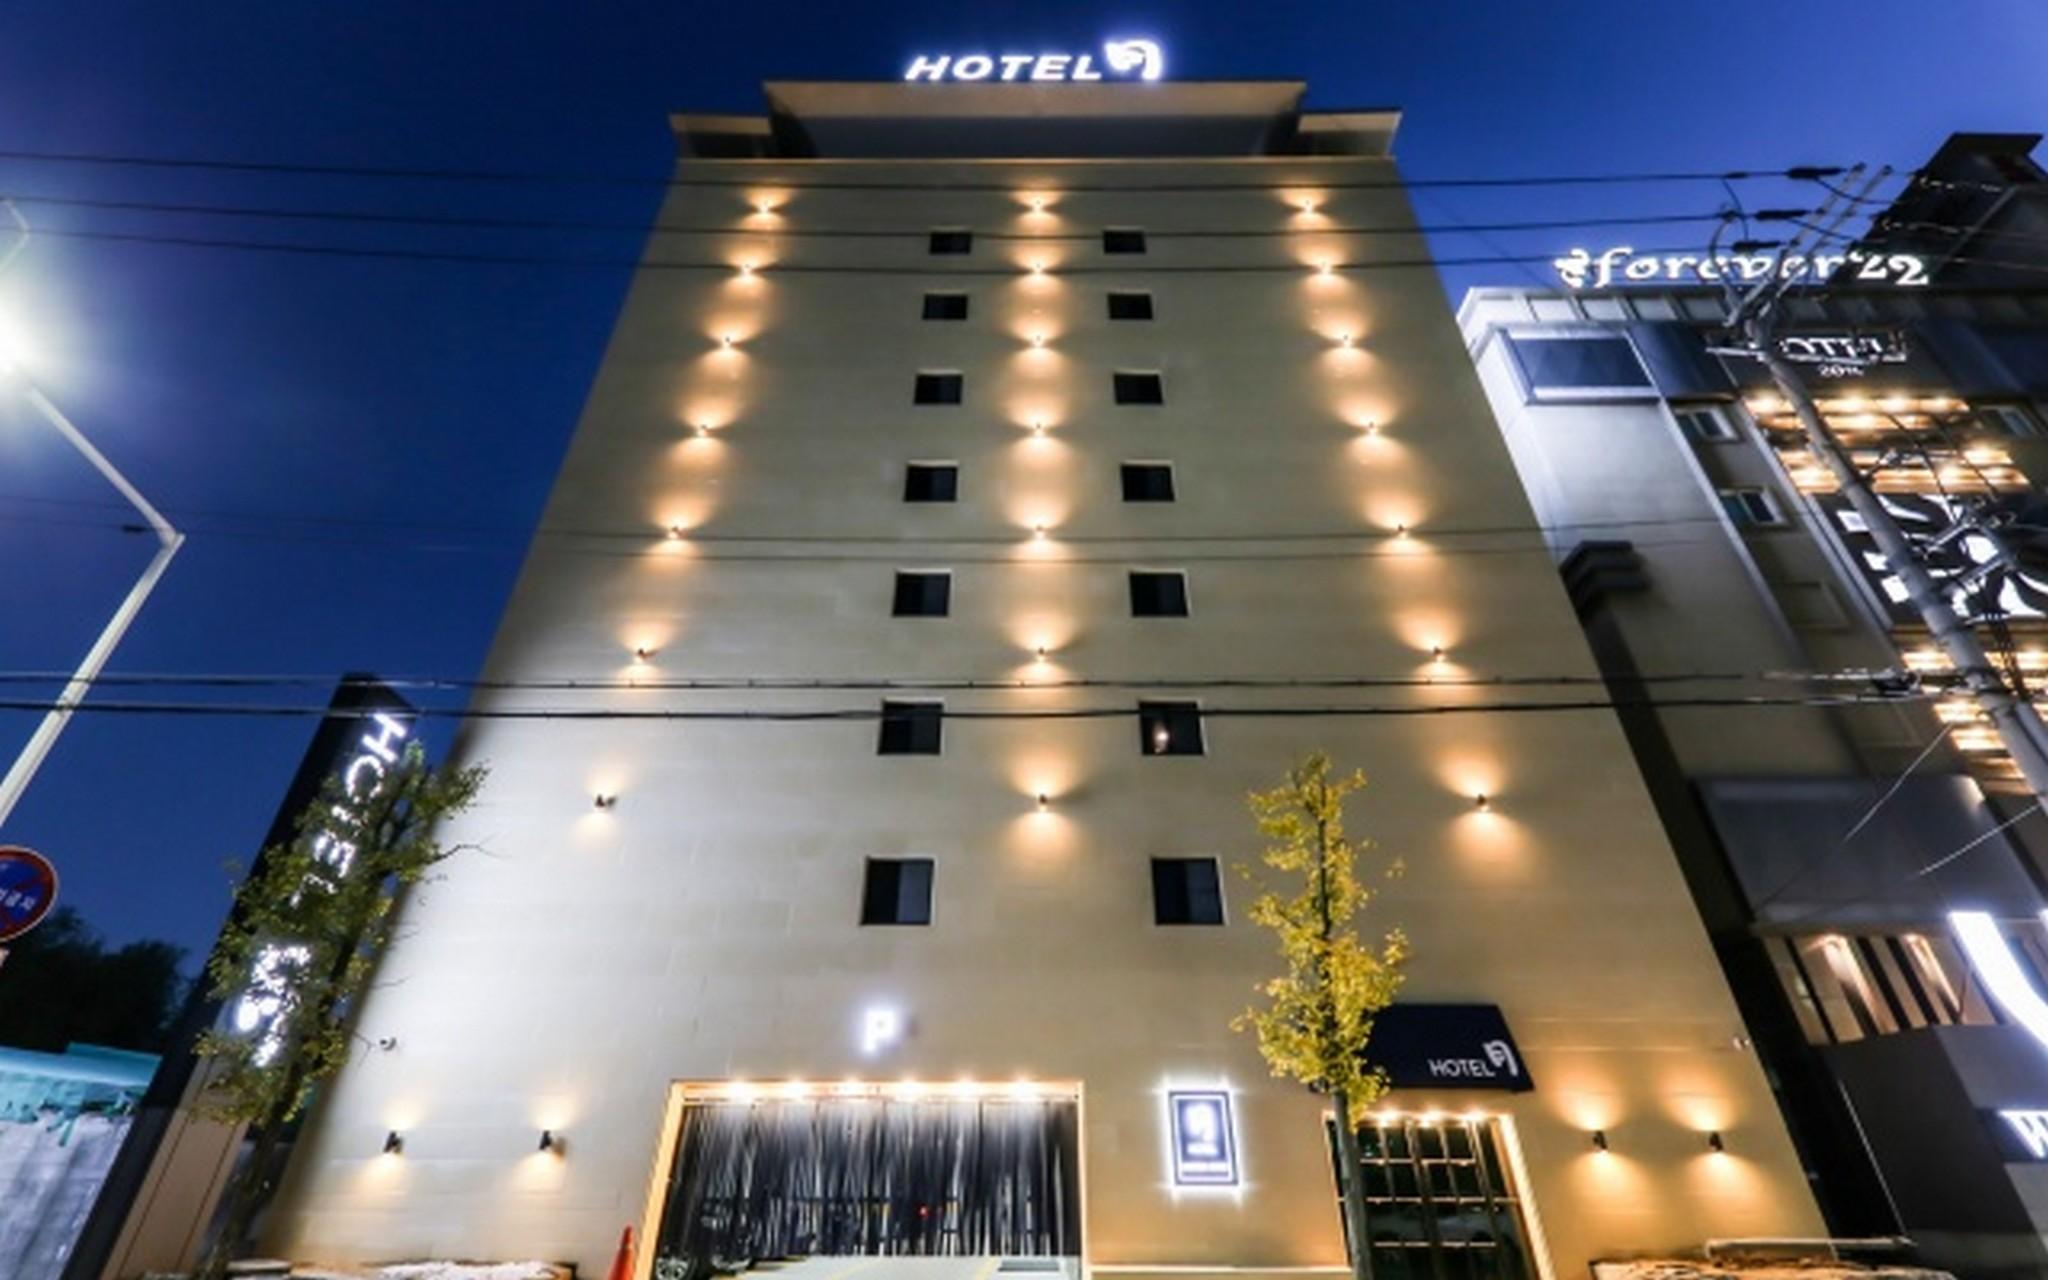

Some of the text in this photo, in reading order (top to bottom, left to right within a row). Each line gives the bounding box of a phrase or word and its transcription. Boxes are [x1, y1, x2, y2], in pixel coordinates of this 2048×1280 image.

[904, 55, 1102, 80] HOTEL
[863, 1010, 897, 1052] P
[1428, 1059, 1496, 1077] HOTEL
